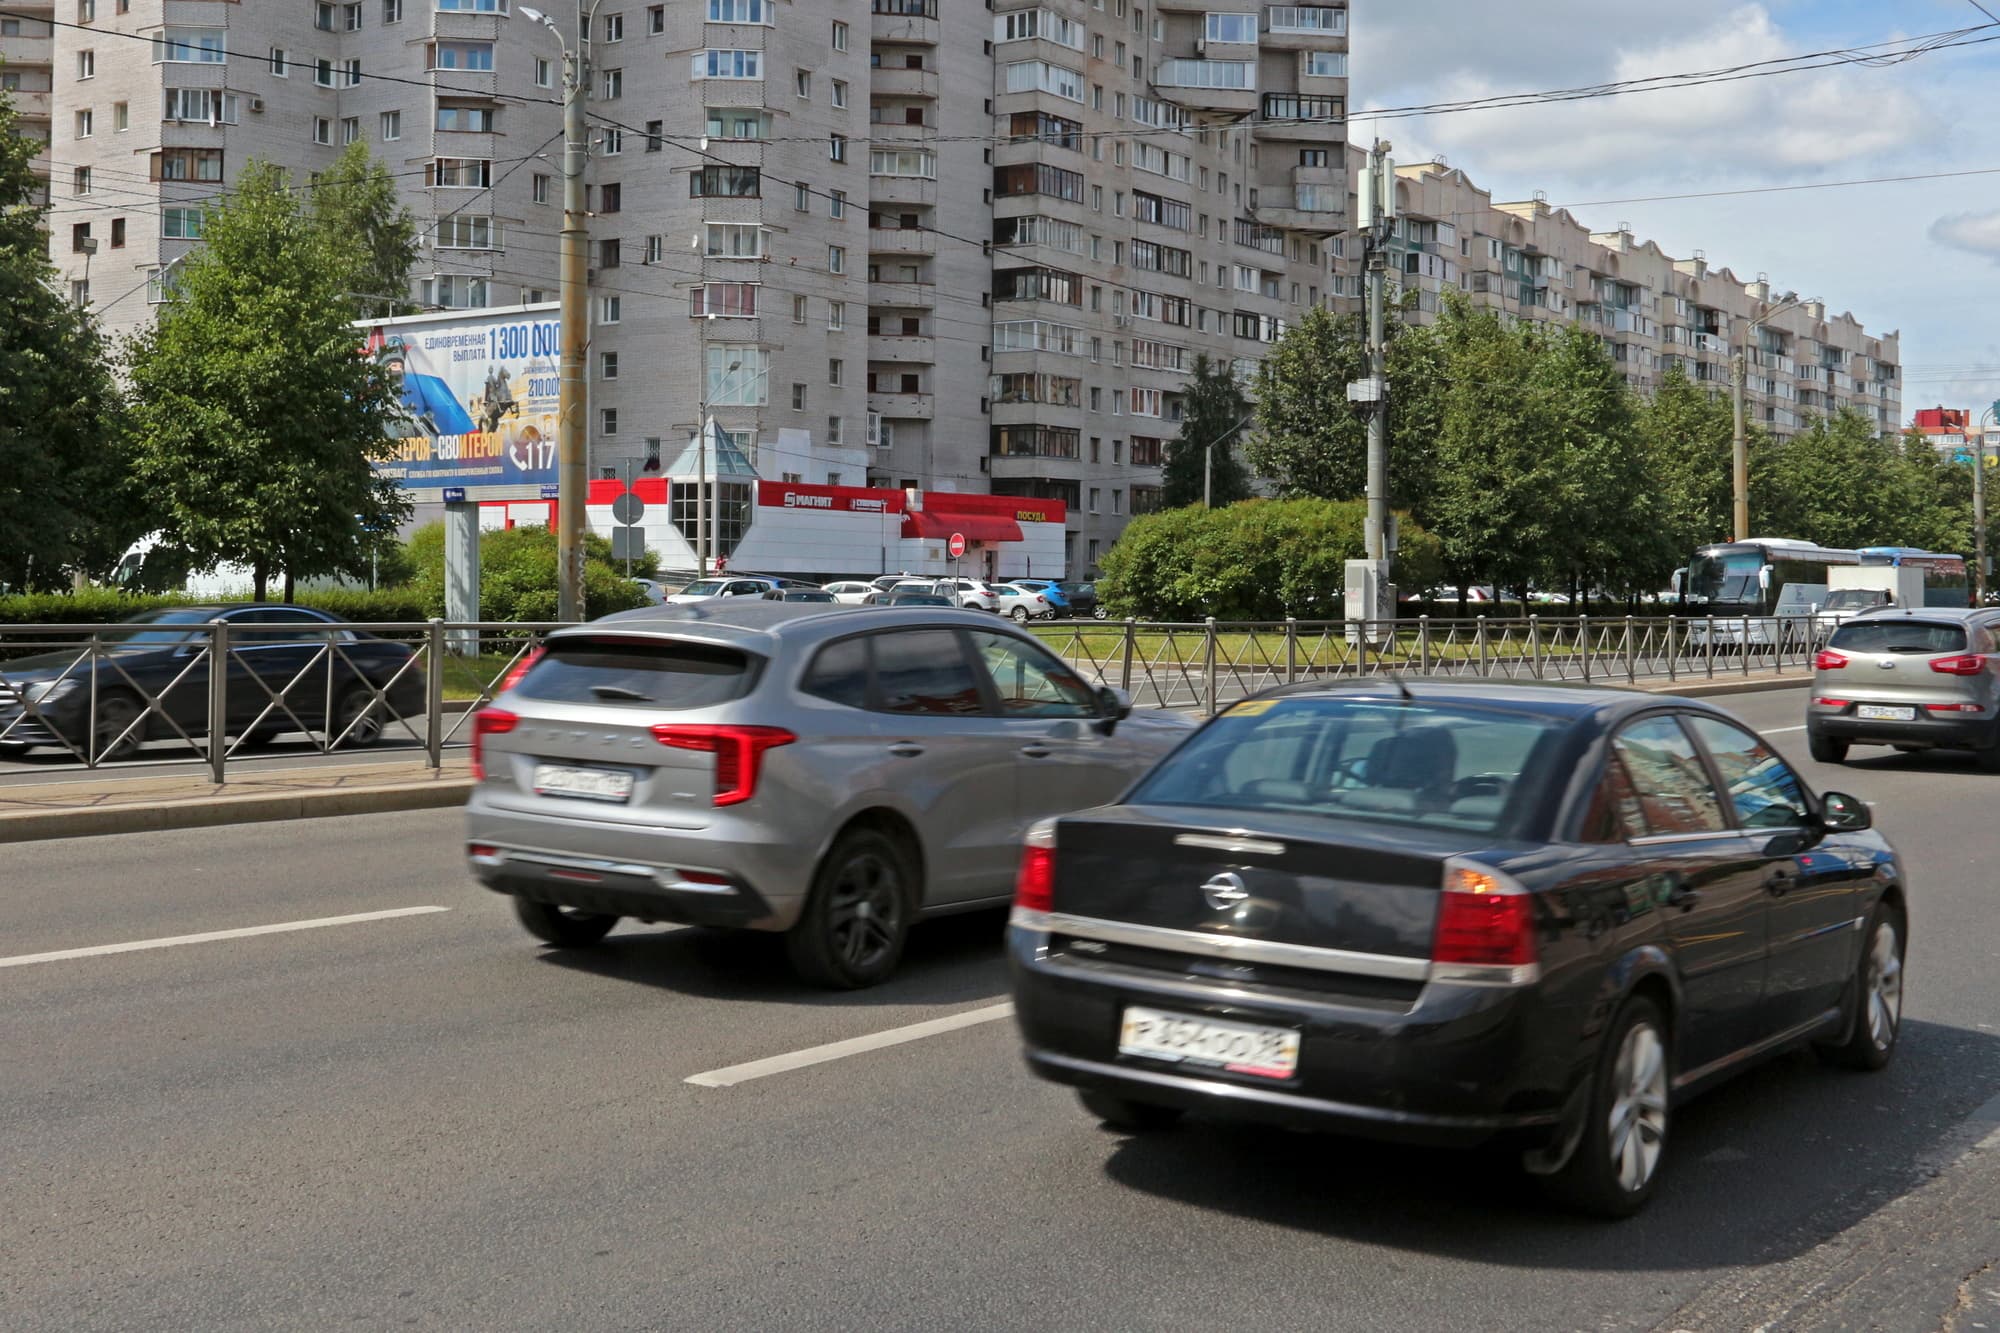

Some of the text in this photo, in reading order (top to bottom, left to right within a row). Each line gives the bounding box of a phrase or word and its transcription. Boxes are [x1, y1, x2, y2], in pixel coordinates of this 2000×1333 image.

[425, 333, 486, 350] ЕДИНОВРЕМЕННАЯ
[500, 325, 528, 359] 300
[453, 348, 486, 362] ВЫПЛАТА
[528, 378, 543, 397] 210
[526, 441, 555, 469] 117
[796, 495, 833, 507] МАГНИТ
[1017, 511, 1046, 522] ПОСУДА
